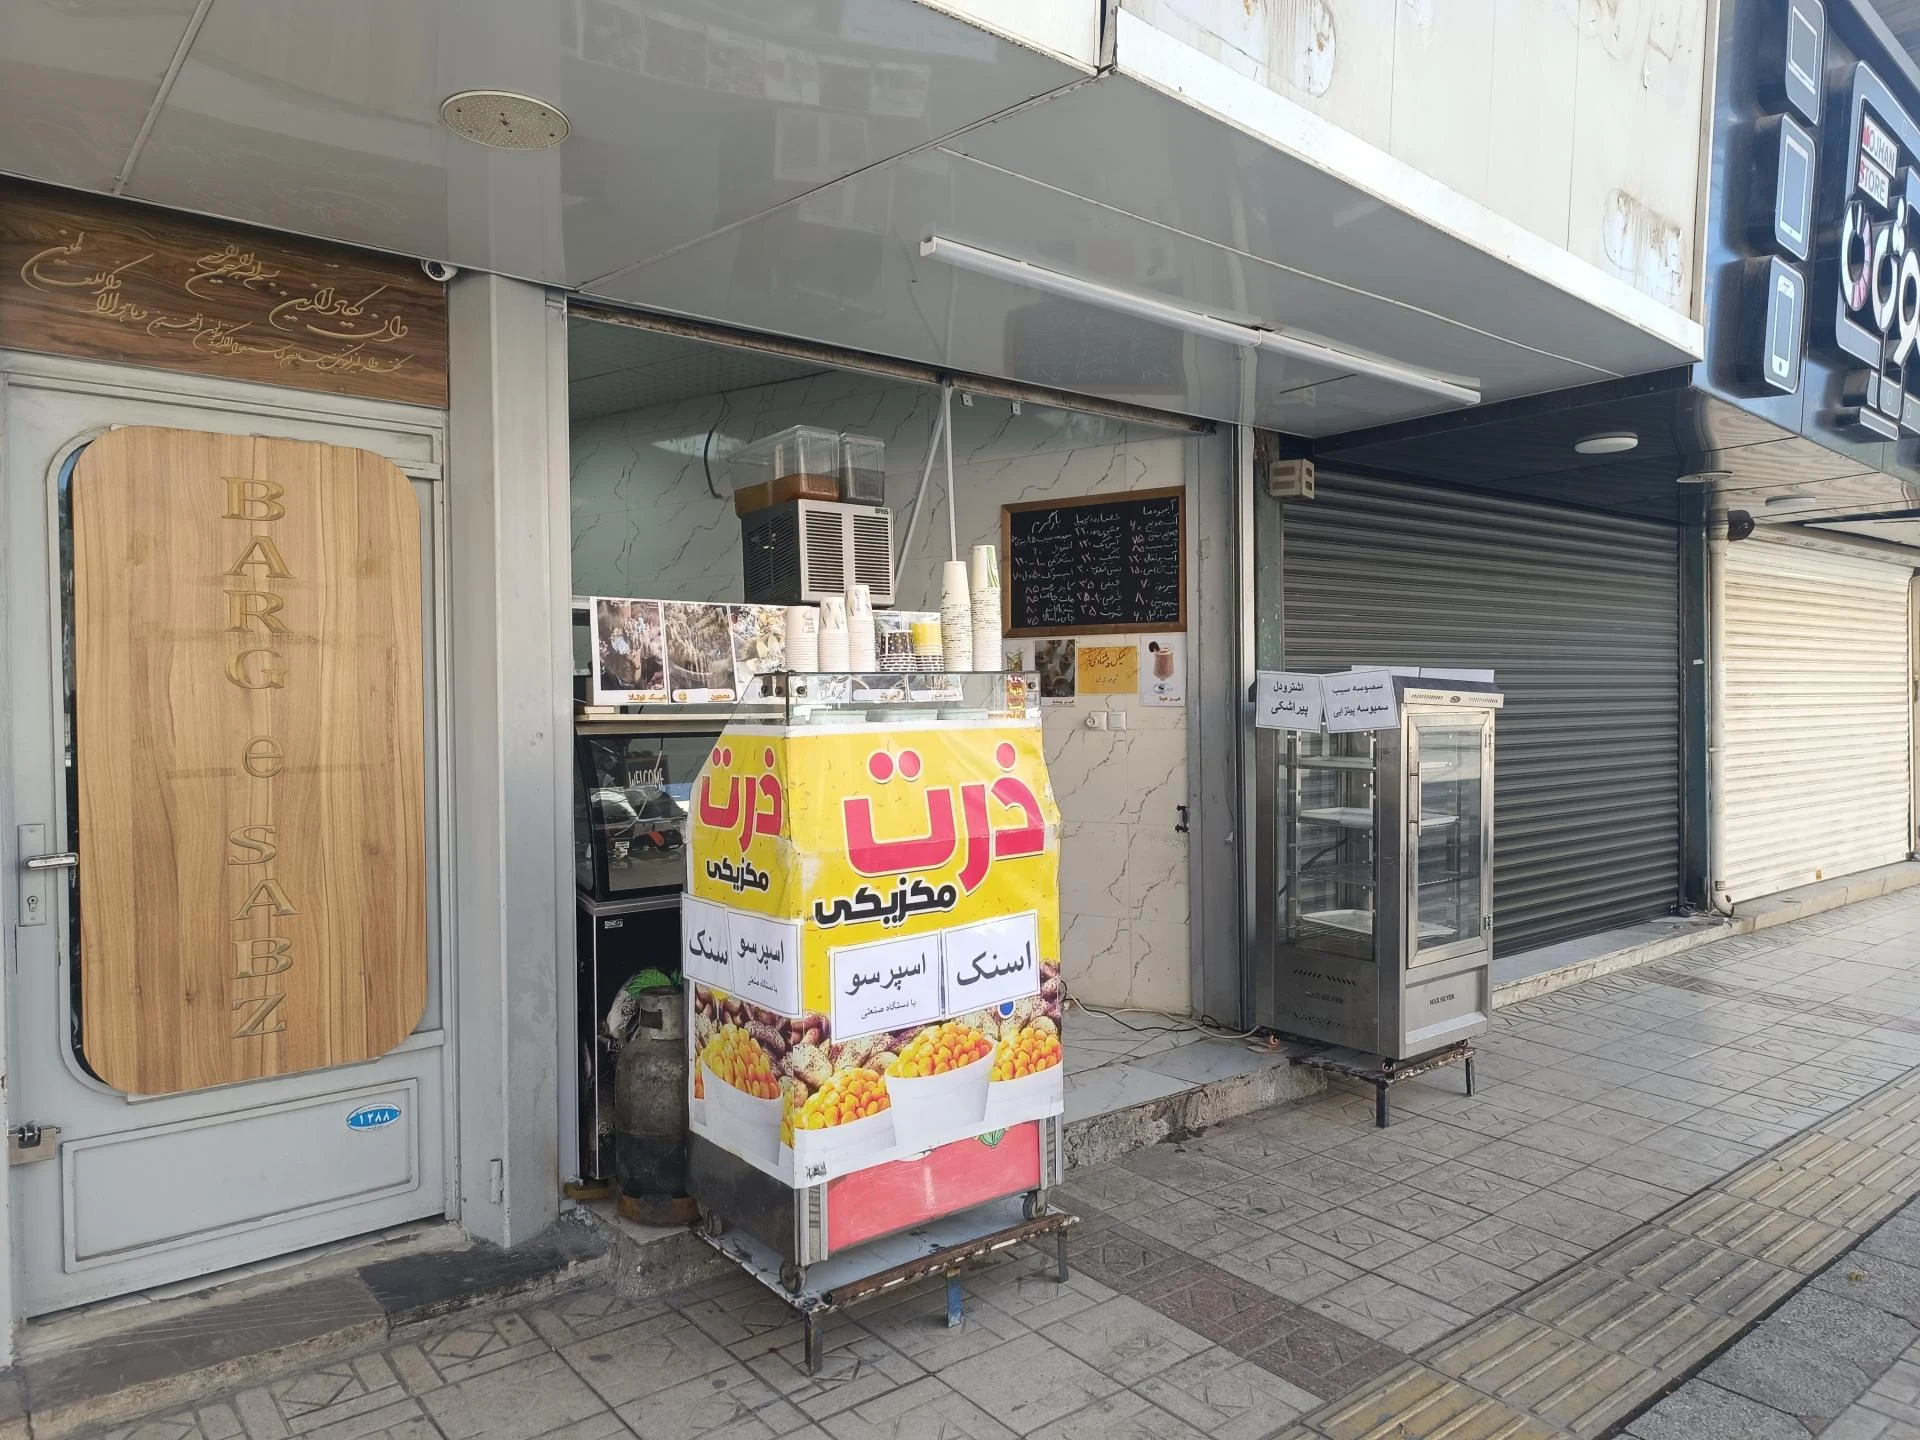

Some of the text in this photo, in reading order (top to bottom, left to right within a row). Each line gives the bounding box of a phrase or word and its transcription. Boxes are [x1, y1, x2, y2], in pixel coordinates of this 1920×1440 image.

[1863, 126, 1895, 173] MOJHAN
[1860, 160, 1885, 202] STORE
[1273, 681, 1304, 694] اشترودل
[1332, 685, 1383, 696] سمبوسه سیب
[1271, 700, 1309, 717] پیراشکی
[1357, 705, 1388, 715] سمبوسه
[628, 768, 664, 789] WELCOME
[700, 747, 783, 853] ذرت
[843, 742, 1045, 896] ذرت
[706, 857, 769, 892] مکزیکی
[814, 875, 957, 927] مکزیکی
[690, 929, 728, 965] سنک
[737, 937, 784, 970] اسپرسو
[956, 941, 1032, 987] اسنک
[845, 951, 927, 996] اسپرسو
[360, 1110, 390, 1125] ۱۲۸۸
